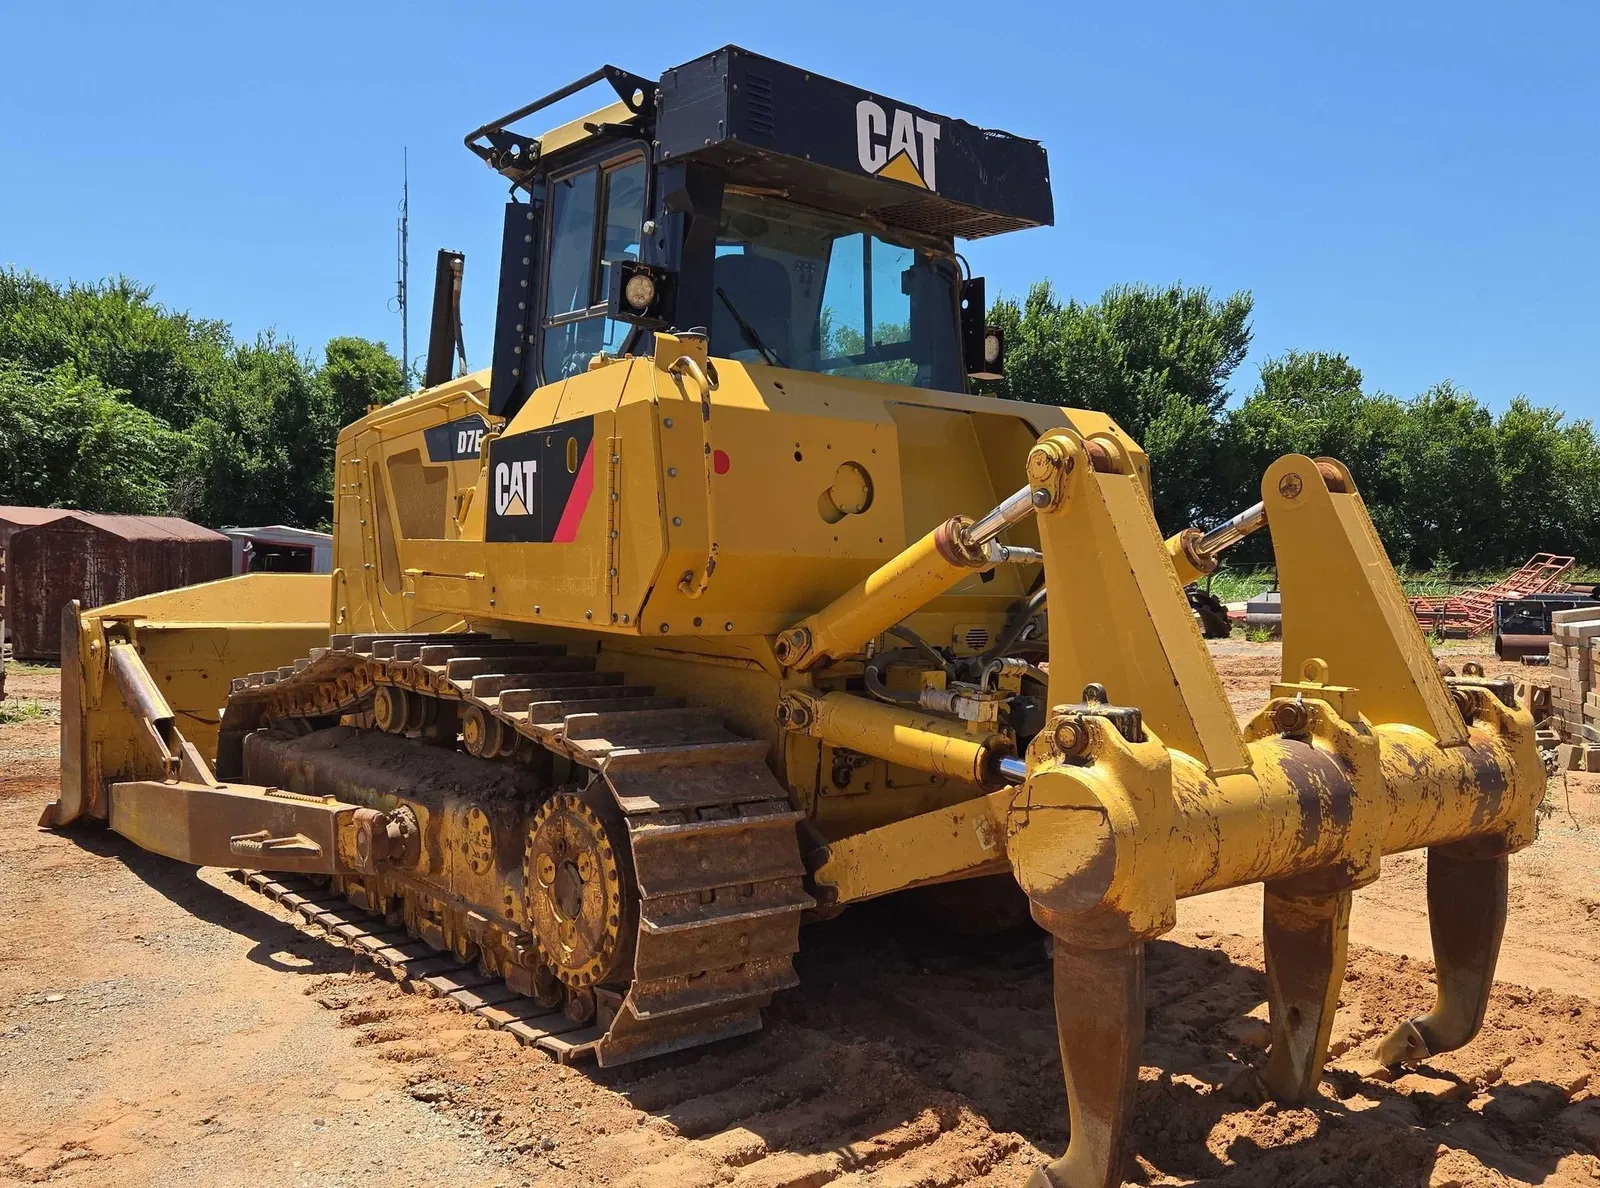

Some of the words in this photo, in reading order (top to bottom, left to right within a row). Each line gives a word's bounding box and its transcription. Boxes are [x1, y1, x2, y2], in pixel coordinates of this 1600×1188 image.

[856, 100, 941, 192] CAT
[457, 429, 484, 454] D7E
[495, 460, 537, 516] CAT
